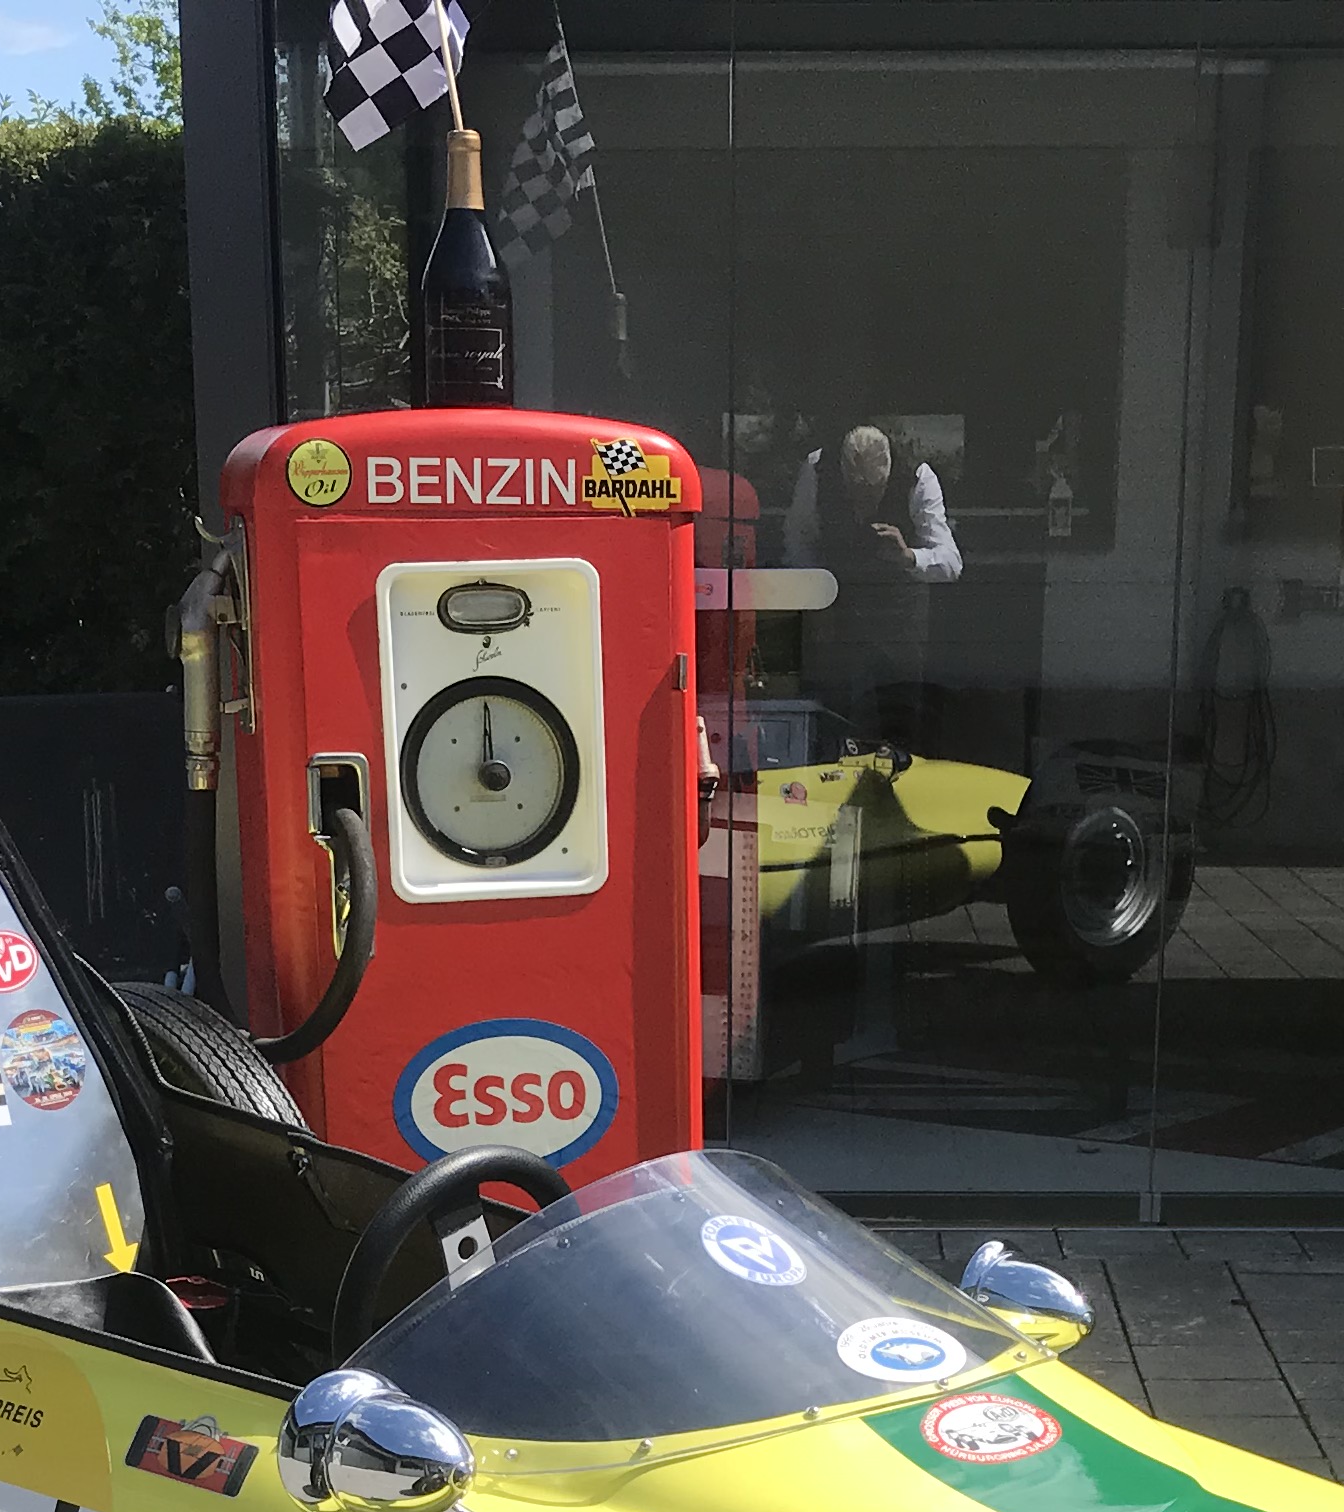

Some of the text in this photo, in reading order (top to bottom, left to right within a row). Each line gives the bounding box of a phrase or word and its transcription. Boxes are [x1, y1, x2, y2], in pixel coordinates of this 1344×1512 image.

[305, 479, 337, 498] Oil
[367, 457, 576, 505] BENZIN
[585, 480, 677, 498] BARDAHL
